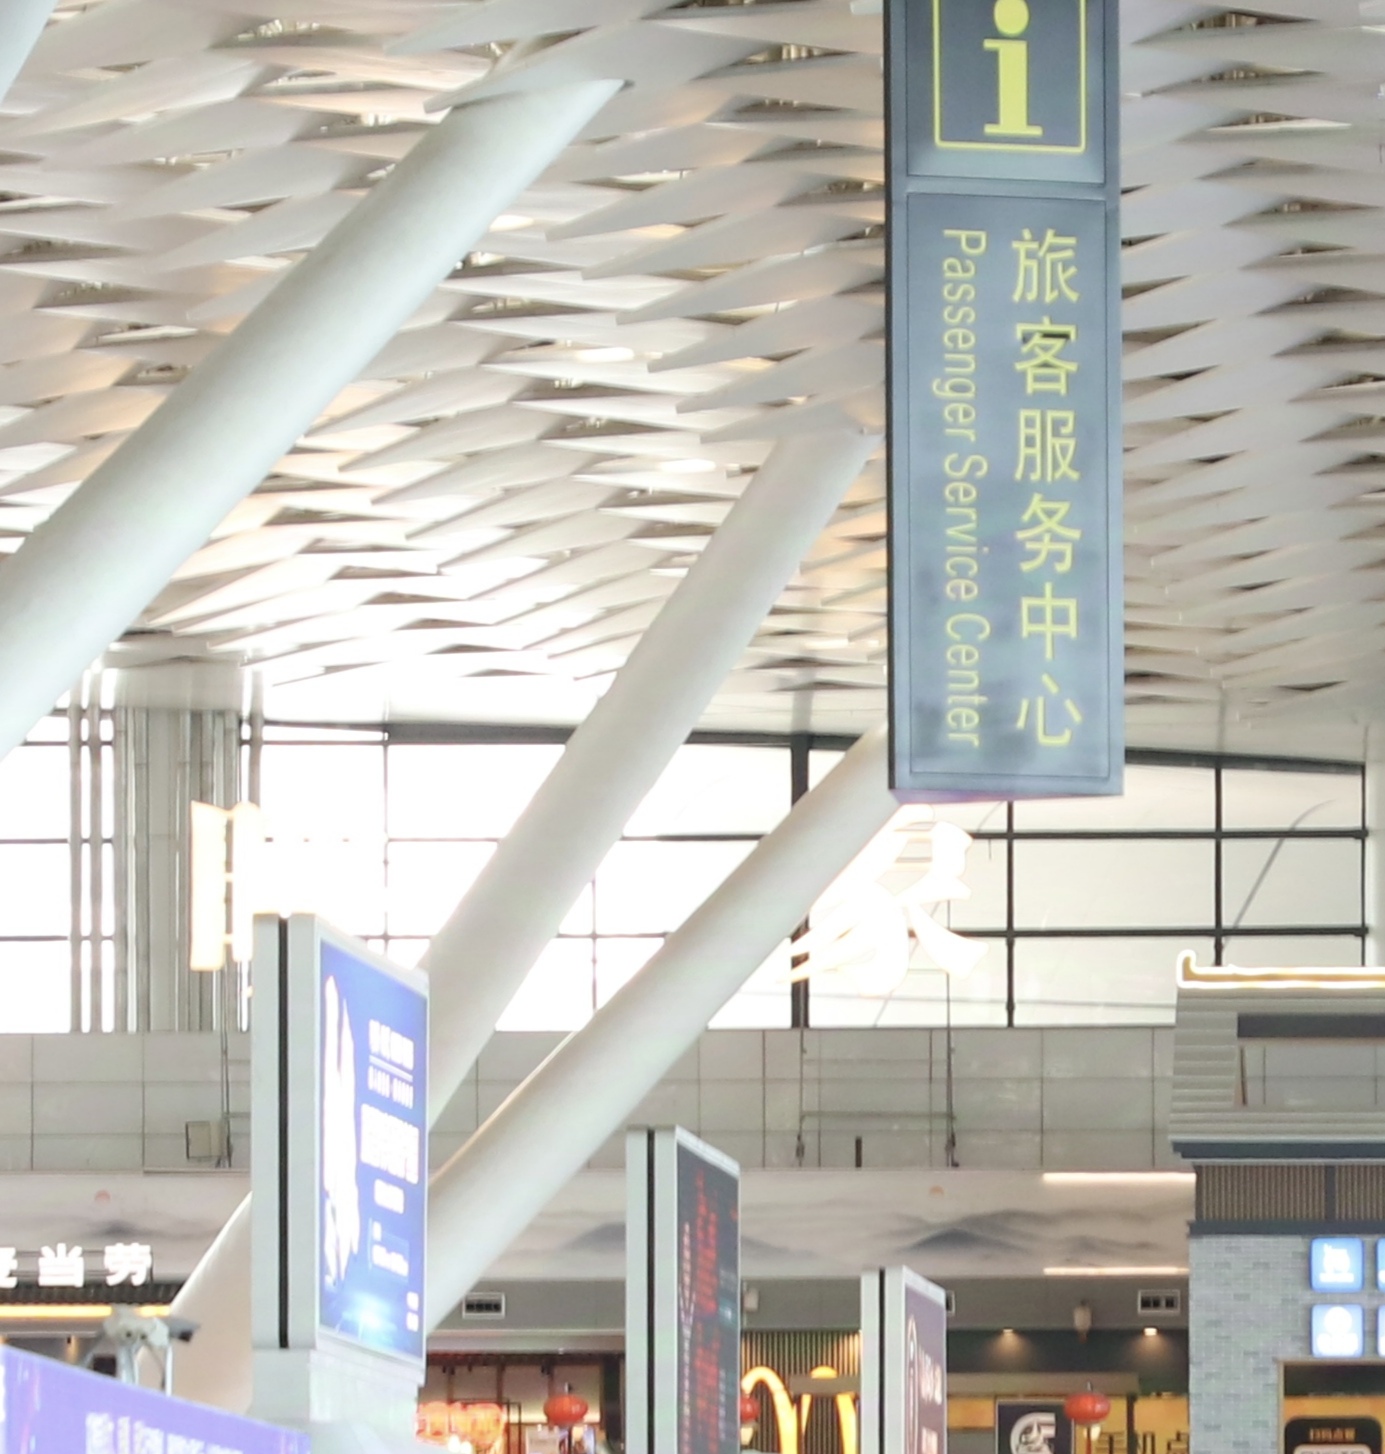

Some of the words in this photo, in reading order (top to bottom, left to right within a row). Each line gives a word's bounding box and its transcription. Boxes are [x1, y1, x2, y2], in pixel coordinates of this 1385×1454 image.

[933, 228, 987, 443] Passenger
[943, 451, 990, 602] Service
[1011, 228, 1083, 748] 旅客服务中心
[944, 612, 991, 749] Center
